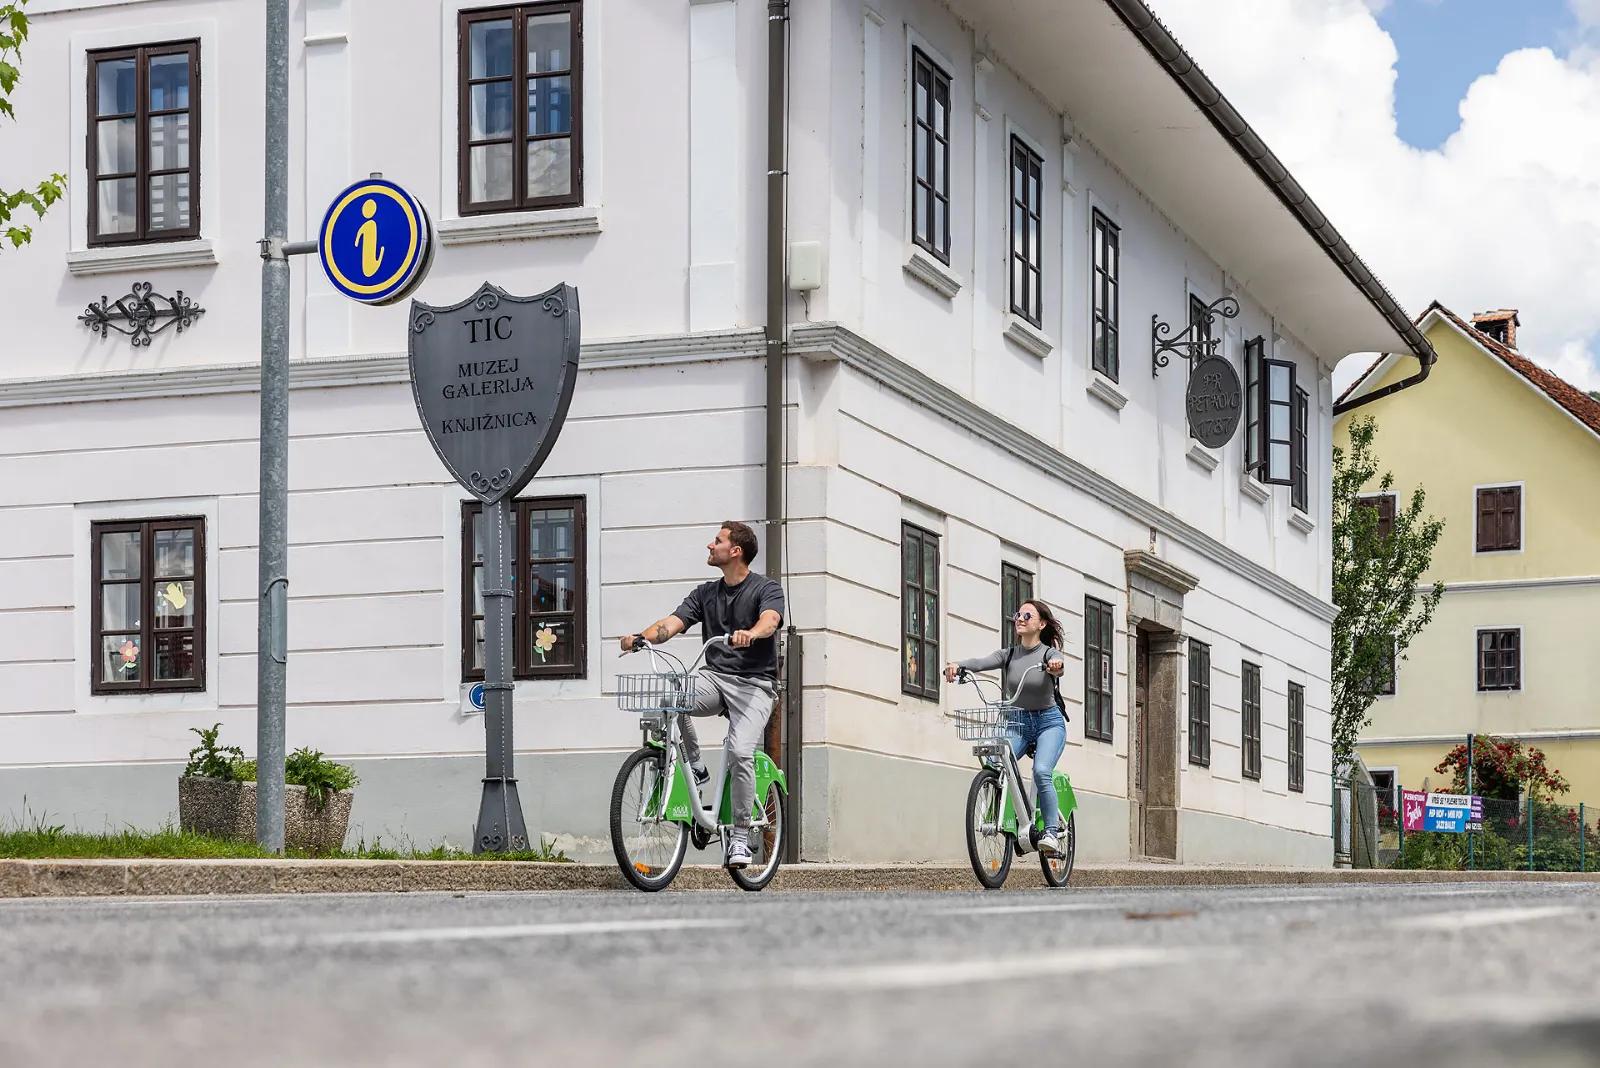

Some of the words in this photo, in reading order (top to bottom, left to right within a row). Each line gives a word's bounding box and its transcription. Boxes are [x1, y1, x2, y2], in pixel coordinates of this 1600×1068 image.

[354, 198, 385, 278] i
[464, 315, 513, 343] TIC
[458, 358, 519, 378] MUZEJ
[442, 376, 534, 400] GALERIJA
[442, 411, 537, 434] KNJIŽNICA
[1197, 416, 1233, 437] 1787
